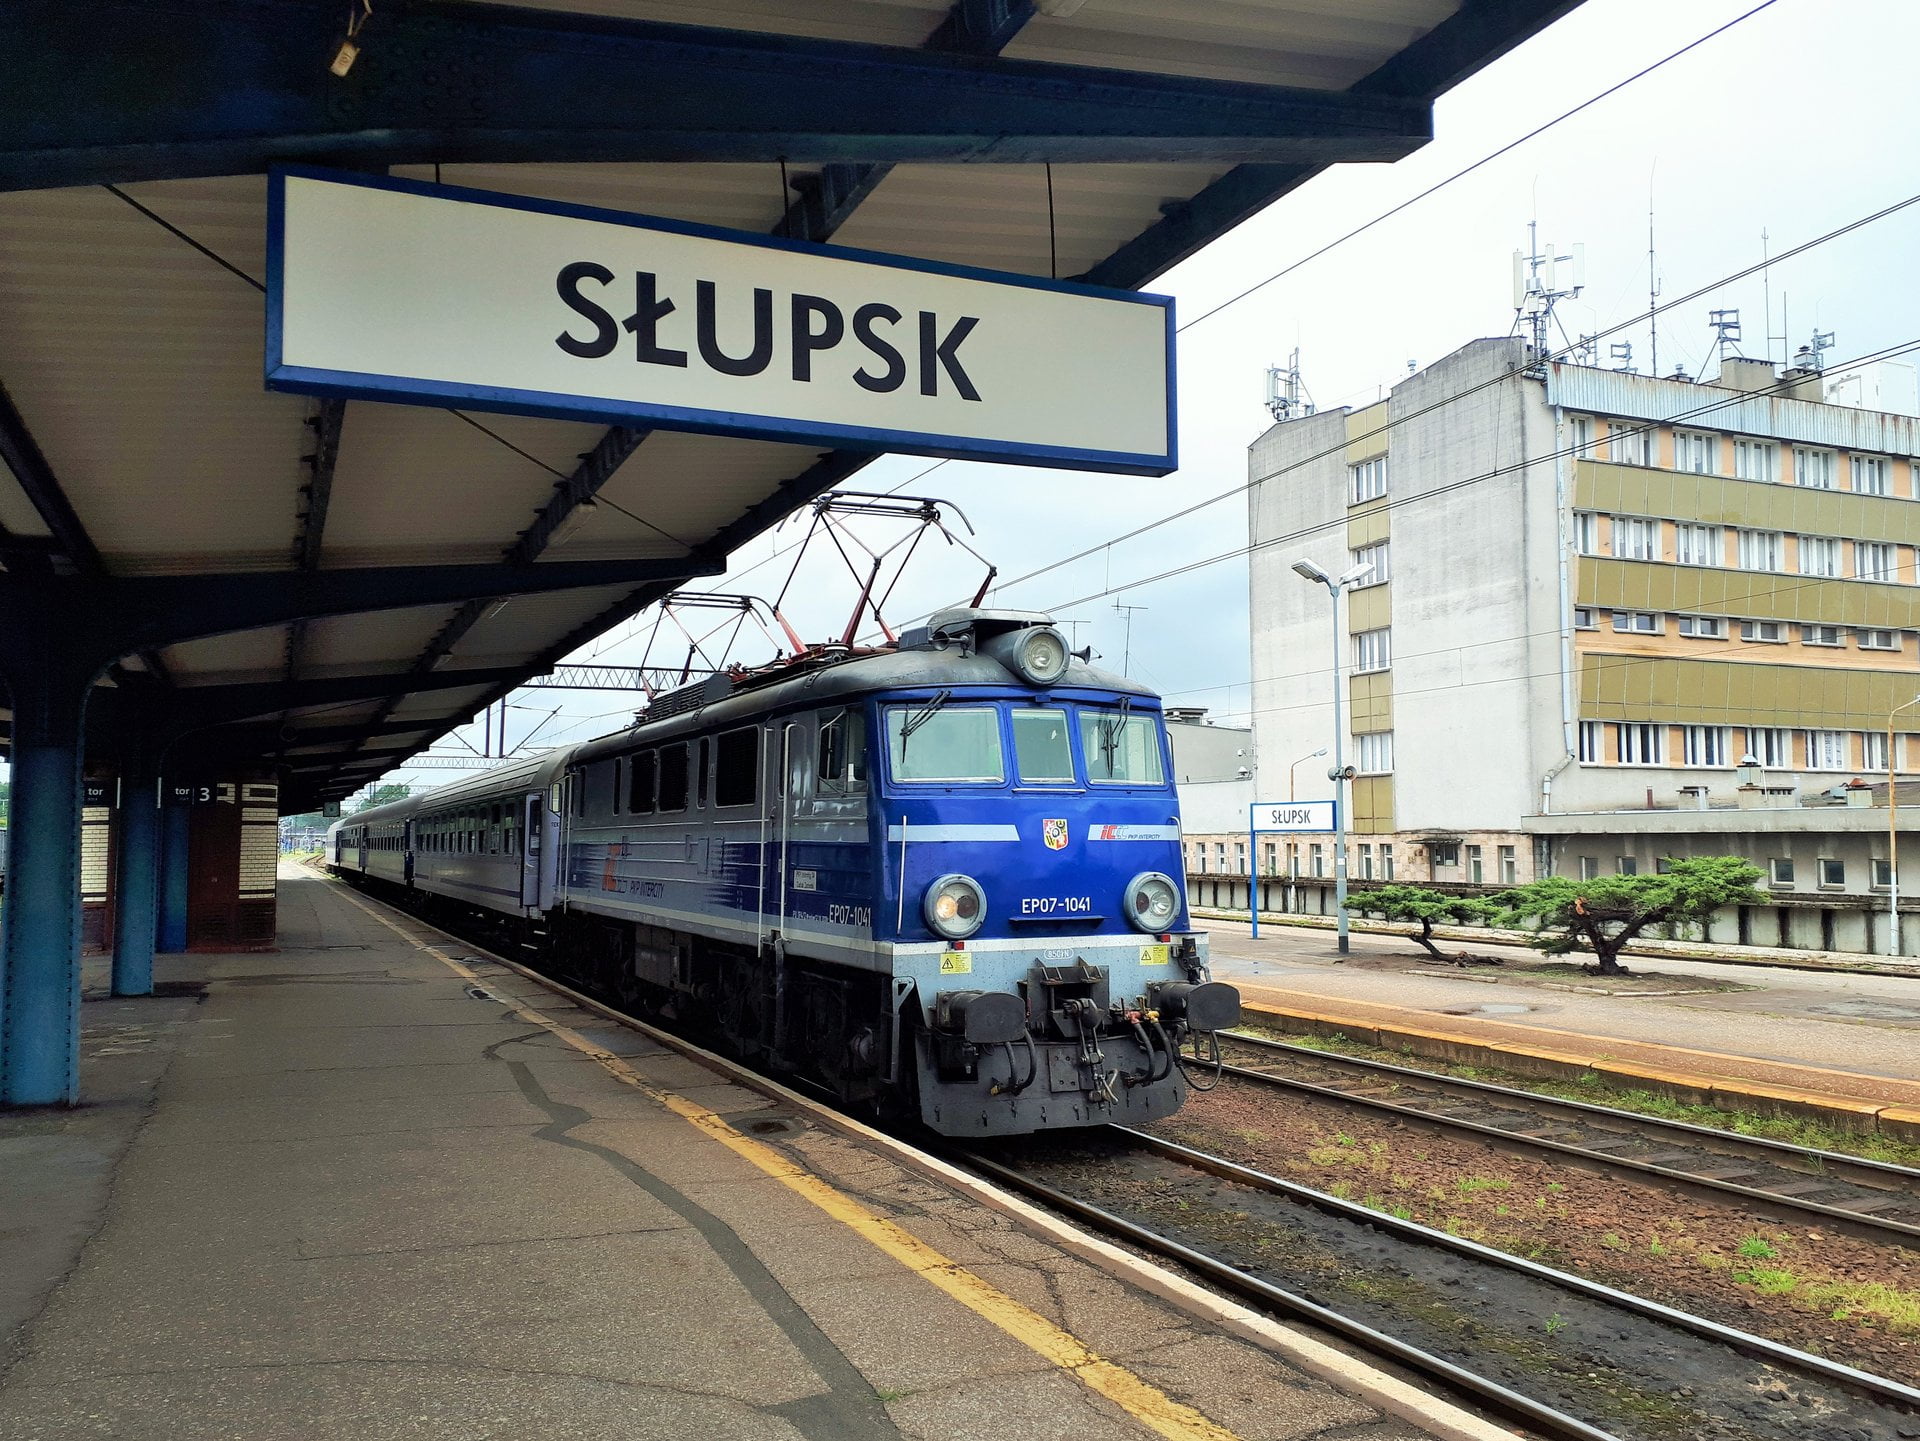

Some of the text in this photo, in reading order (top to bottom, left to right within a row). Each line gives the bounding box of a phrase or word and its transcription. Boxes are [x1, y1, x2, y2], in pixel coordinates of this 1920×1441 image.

[555, 261, 982, 402] SŁUPSK
[88, 788, 103, 796] tor
[175, 787, 210, 801] tor 3
[1272, 809, 1311, 824] SŁUPSK
[1022, 897, 1090, 914] EP07-1041
[829, 904, 871, 927] EP07-1041
